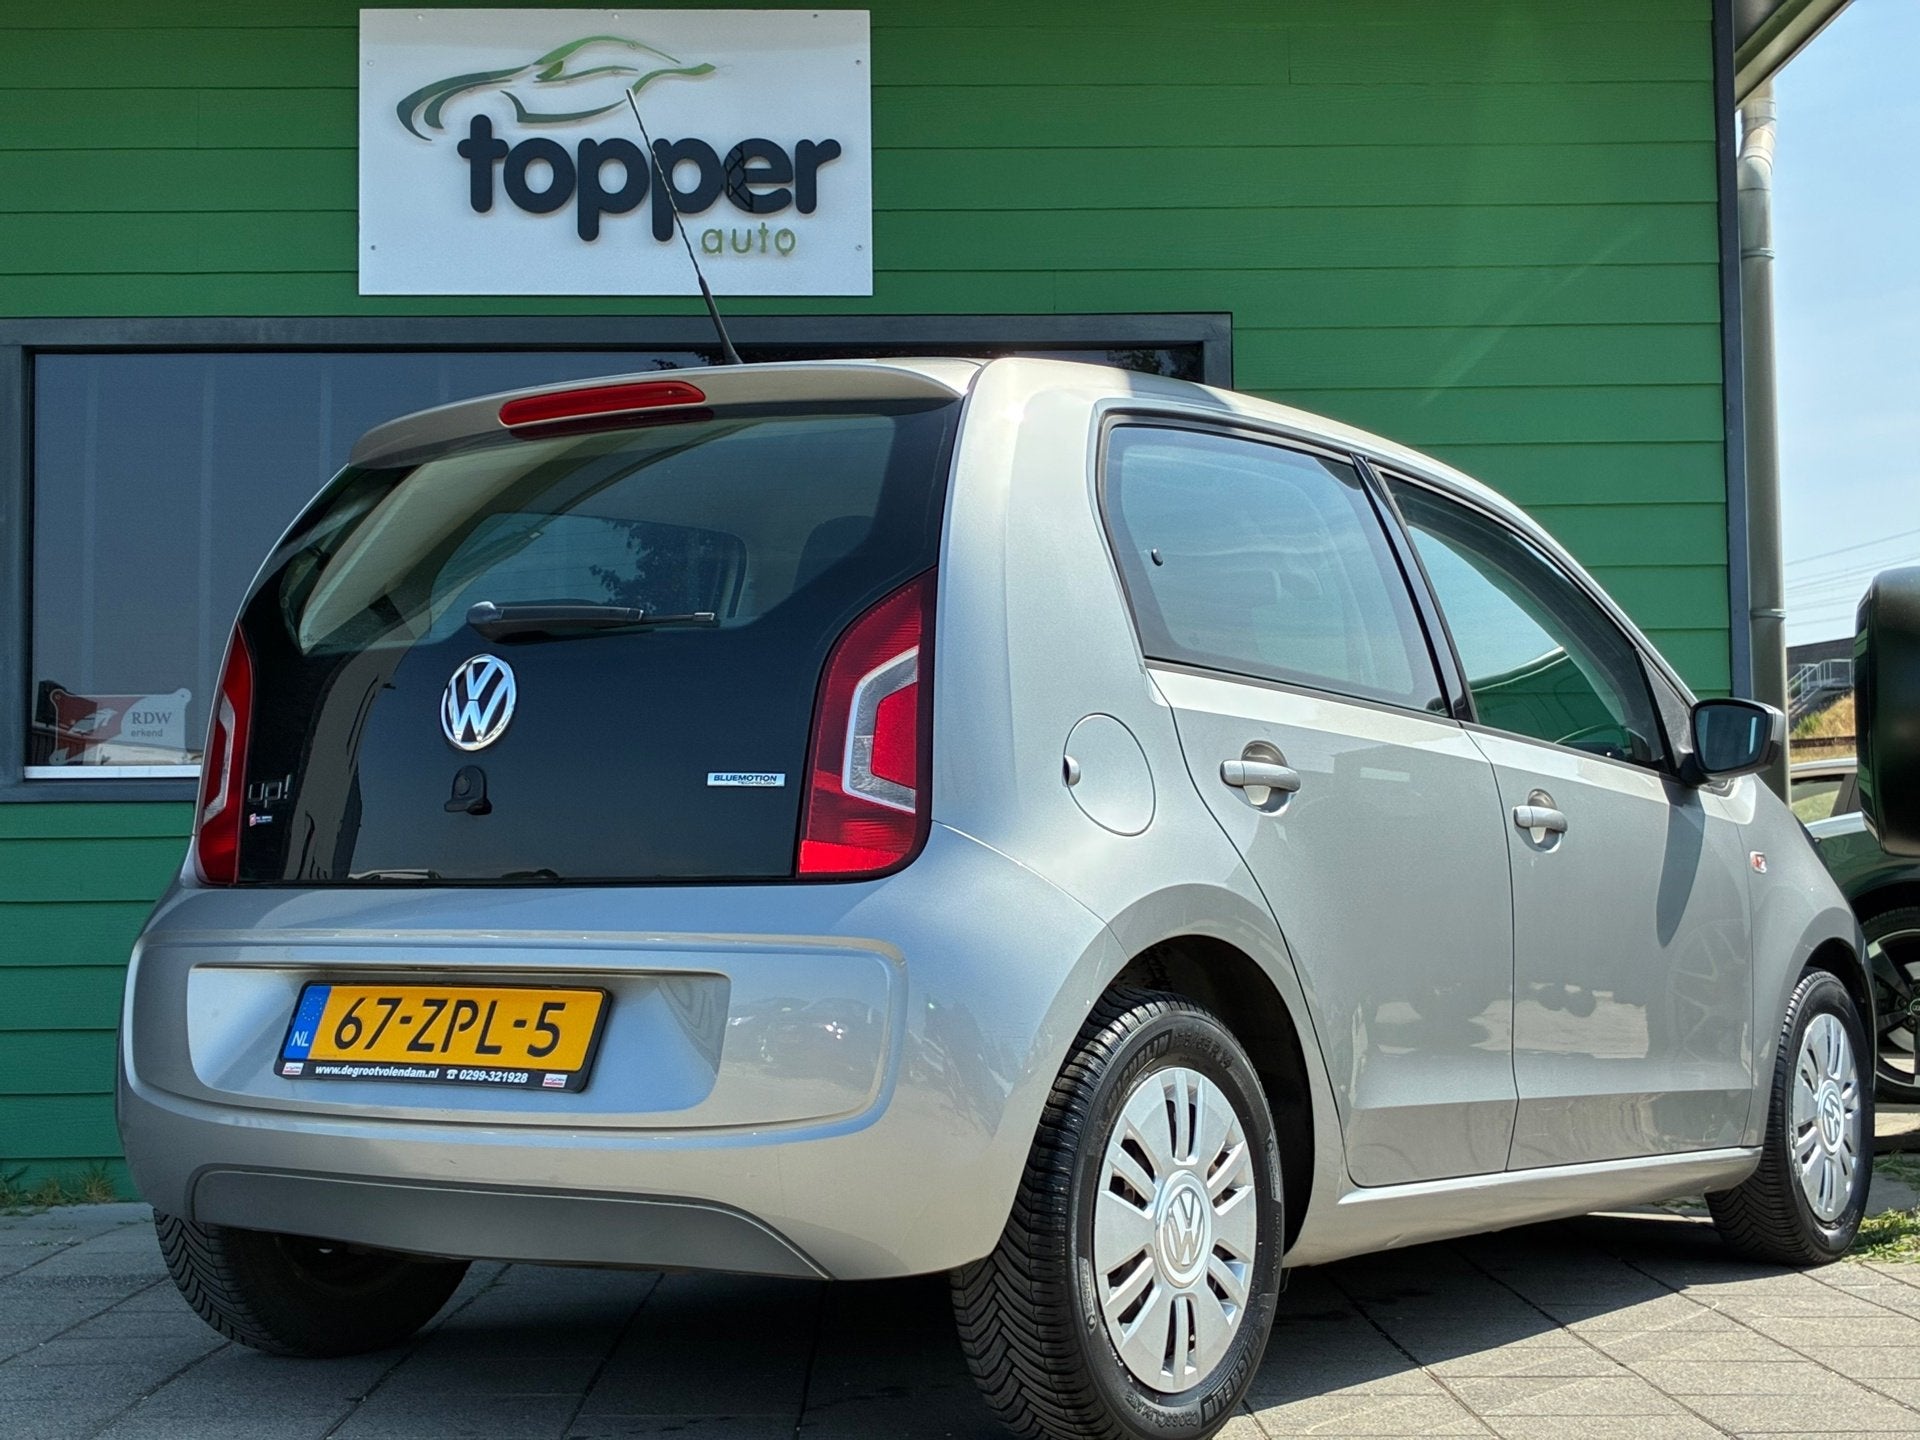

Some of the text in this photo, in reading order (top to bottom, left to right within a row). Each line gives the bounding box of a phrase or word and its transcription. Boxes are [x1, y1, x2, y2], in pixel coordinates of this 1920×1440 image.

[457, 114, 842, 242] topper
[701, 222, 796, 255] auto
[131, 711, 172, 725] RDW
[713, 774, 778, 782] BLUEMOTION
[334, 997, 566, 1058] 67-ZPL-5
[291, 1031, 310, 1047] NL
[315, 1065, 440, 1079] www.degrootvolendam.nl
[459, 1069, 529, 1084] 0299-321928
